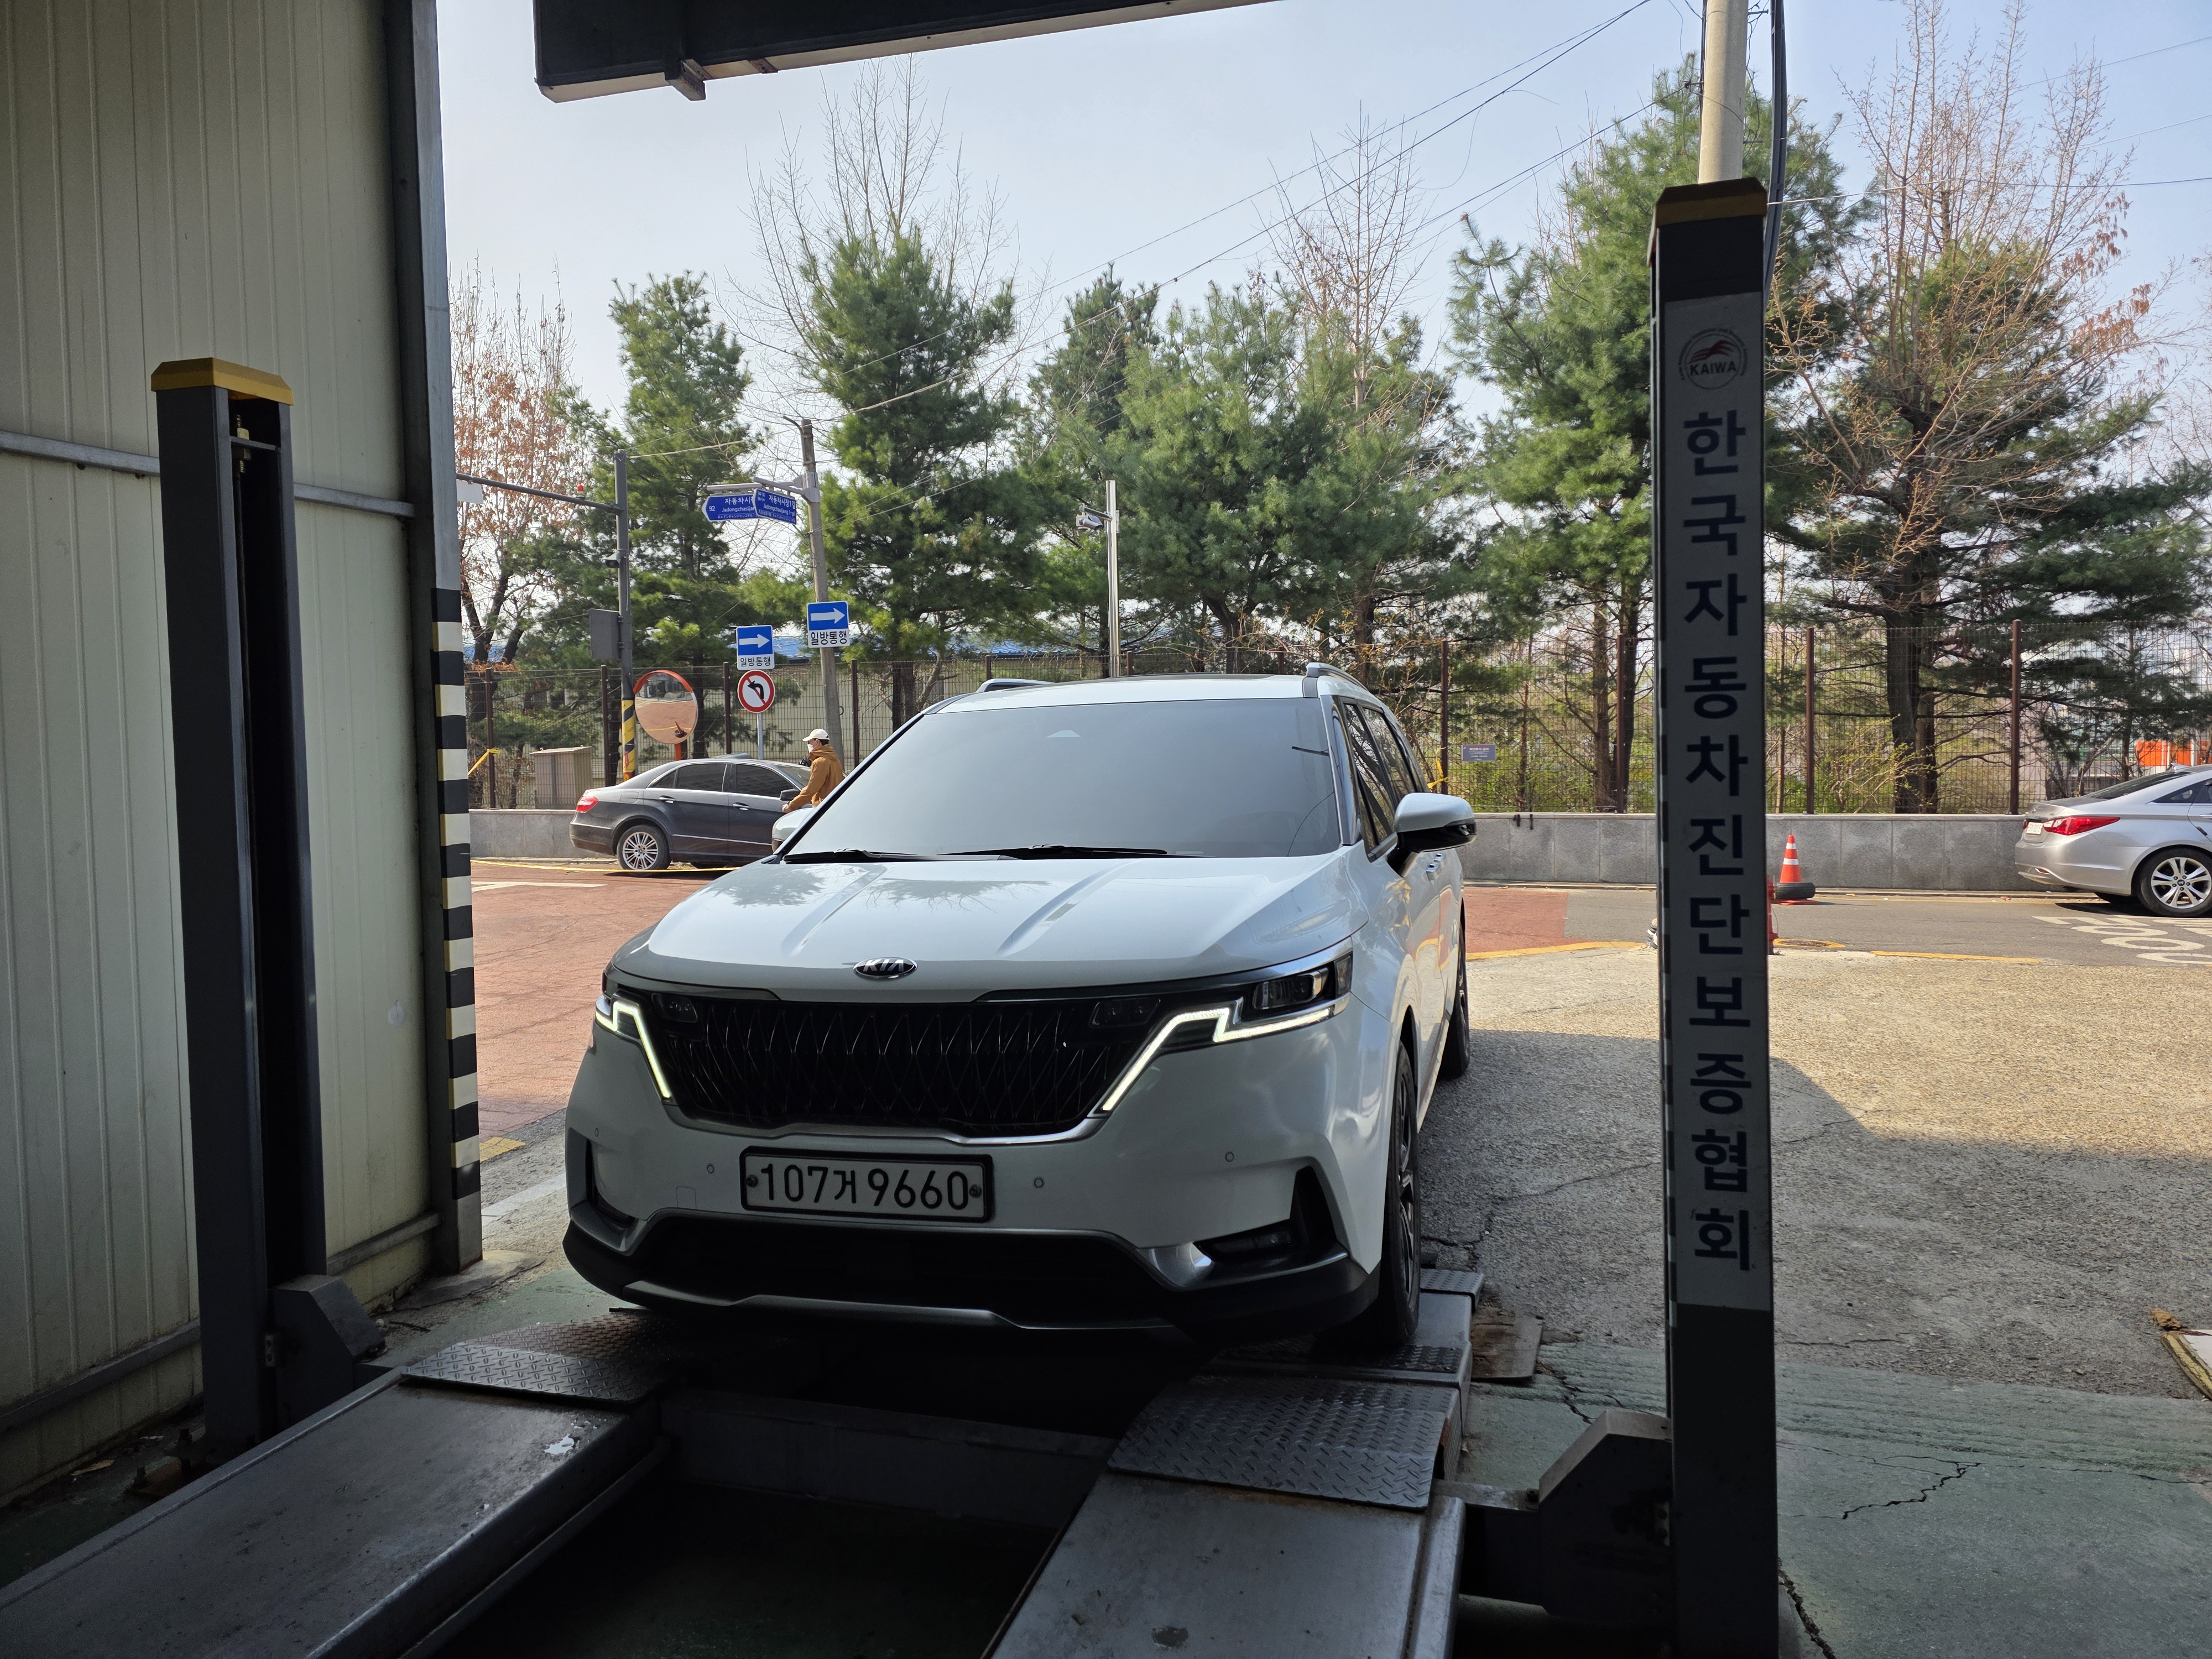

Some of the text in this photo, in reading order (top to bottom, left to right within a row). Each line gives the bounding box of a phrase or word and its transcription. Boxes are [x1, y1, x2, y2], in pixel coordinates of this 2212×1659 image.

[1690, 361, 1737, 375] KAIWA
[724, 496, 753, 505] 자동차시
[811, 630, 847, 645] 일방통행
[740, 656, 771, 667] 일방통행
[1683, 410, 1752, 1271] 한국자동차진단보증협회
[863, 959, 904, 972] KIA
